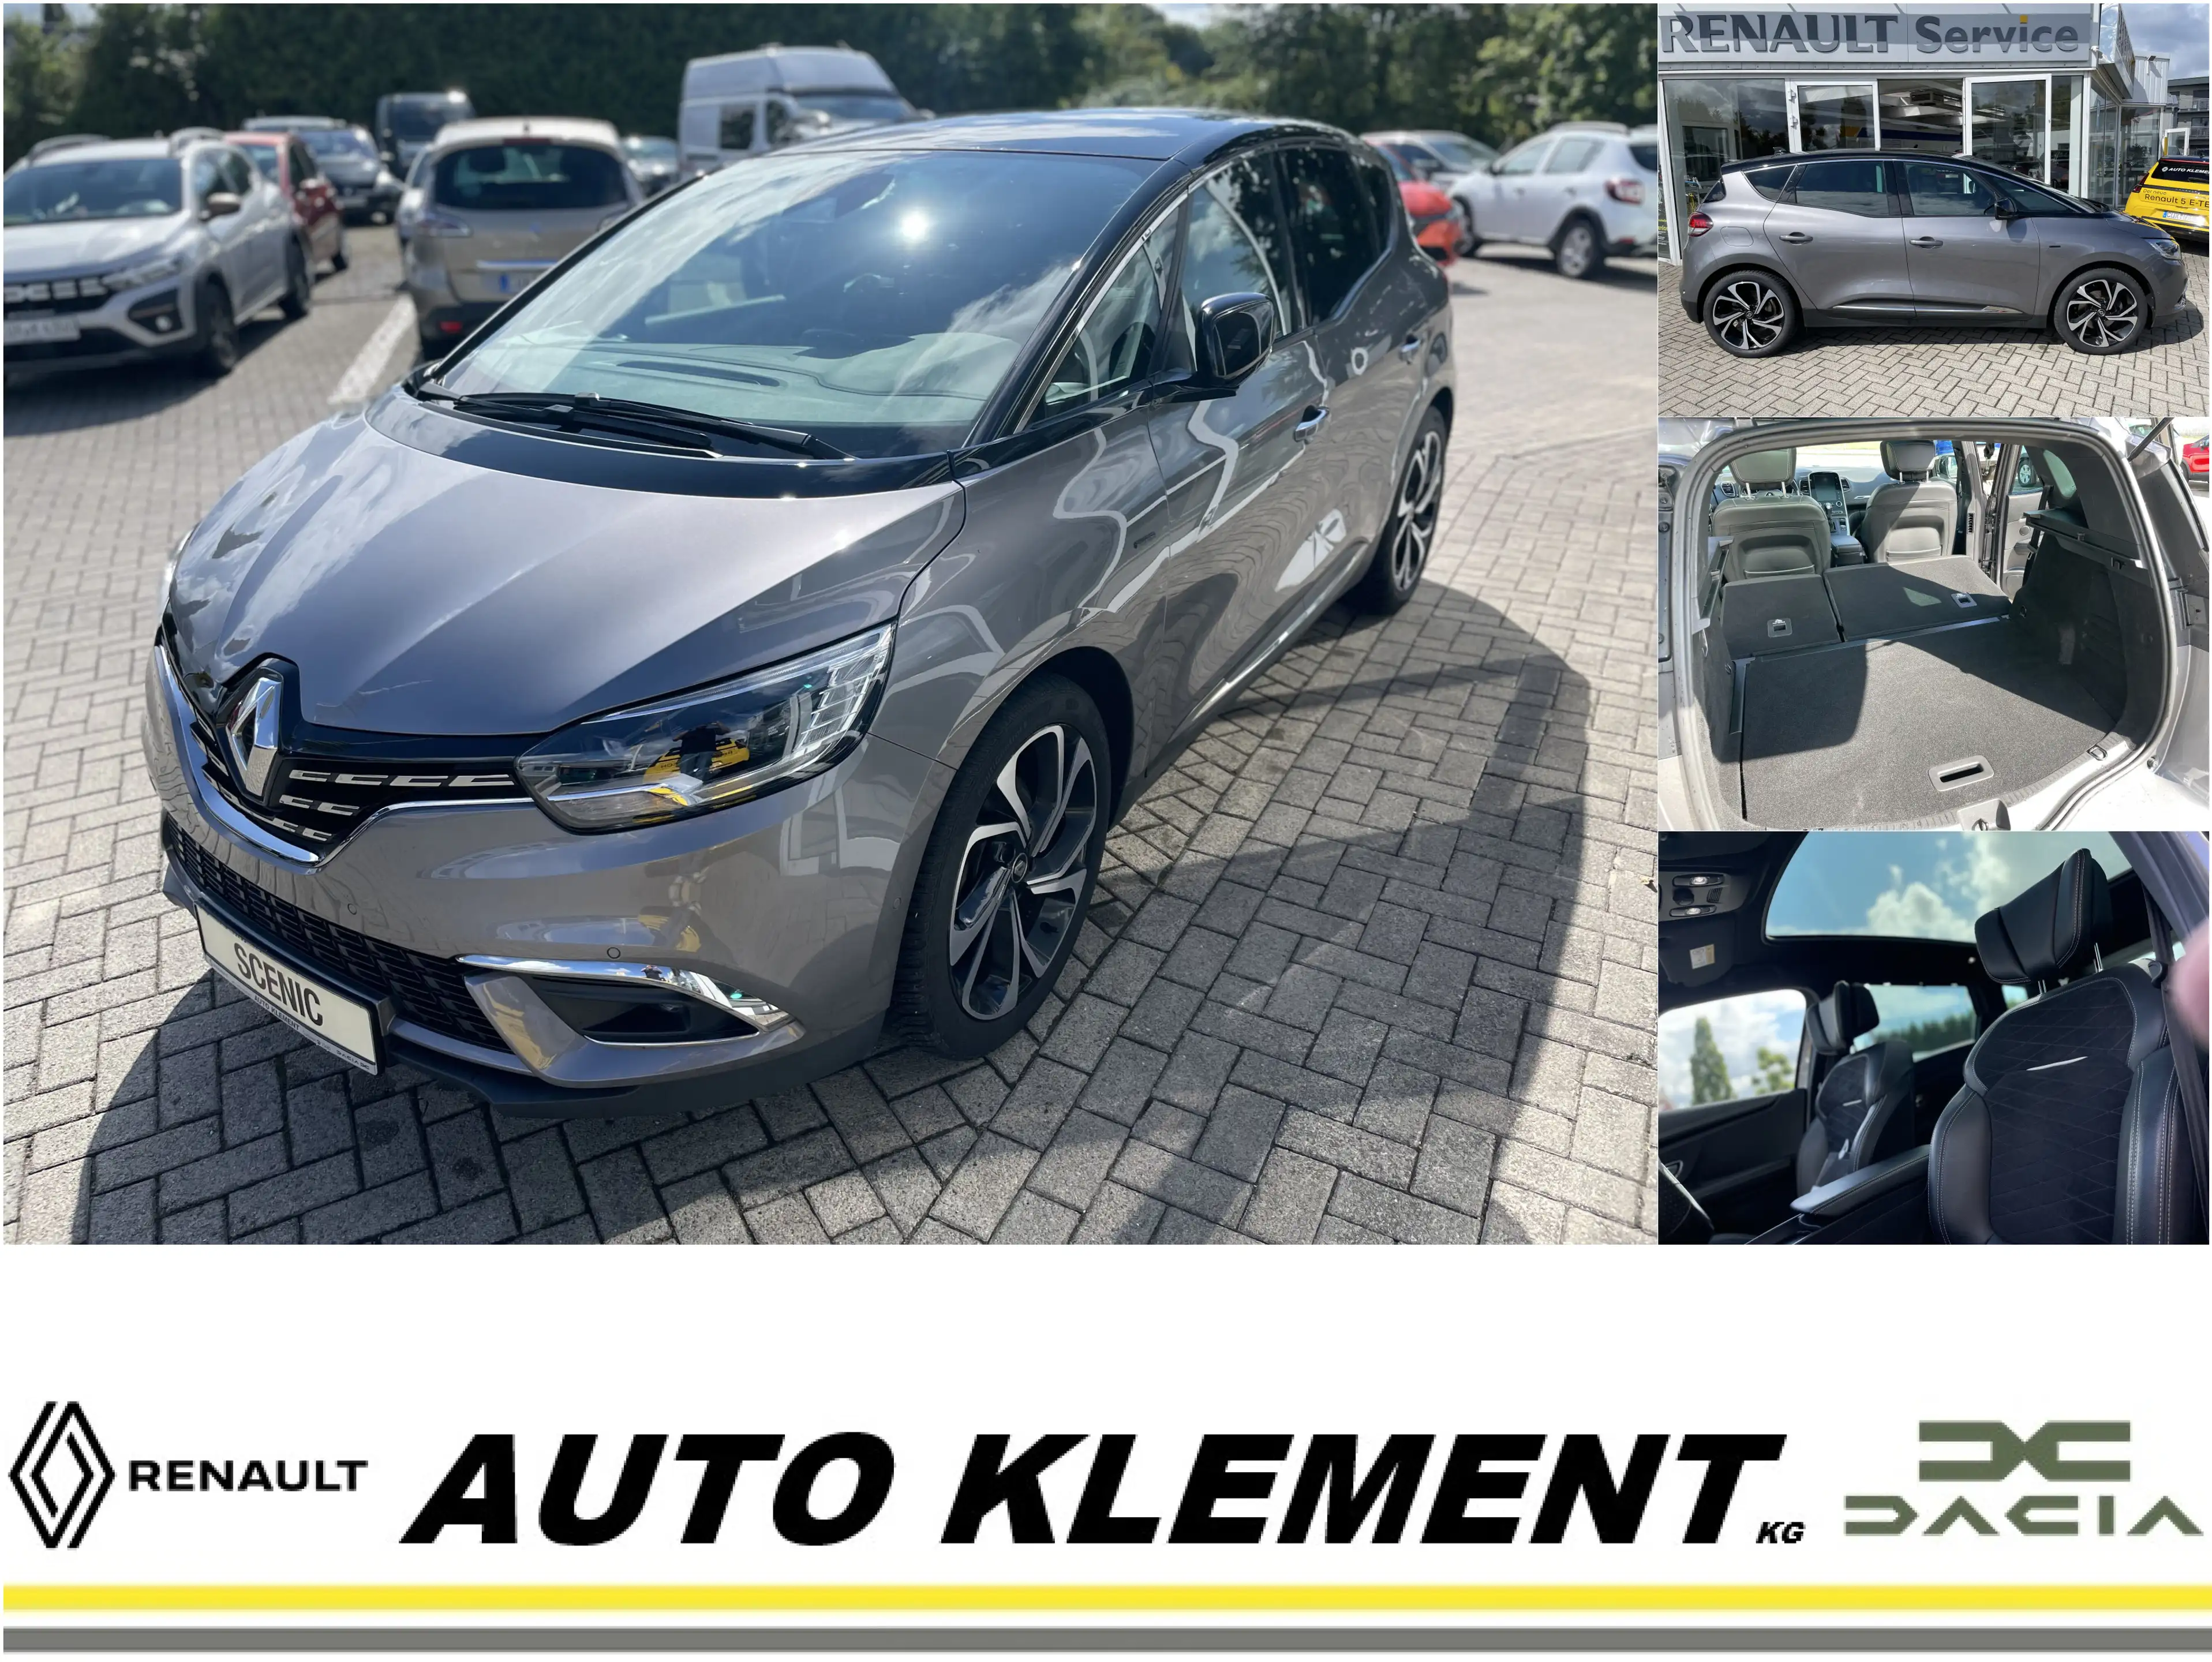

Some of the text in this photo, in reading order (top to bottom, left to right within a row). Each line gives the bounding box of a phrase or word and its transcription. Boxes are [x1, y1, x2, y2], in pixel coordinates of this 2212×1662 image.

[1659, 14, 1898, 53] RENAULT
[1915, 15, 2078, 53] Service
[2144, 193, 2179, 204] Renault
[234, 942, 323, 1027] SCENIC
[254, 995, 301, 1031] AUTO KLEMENT
